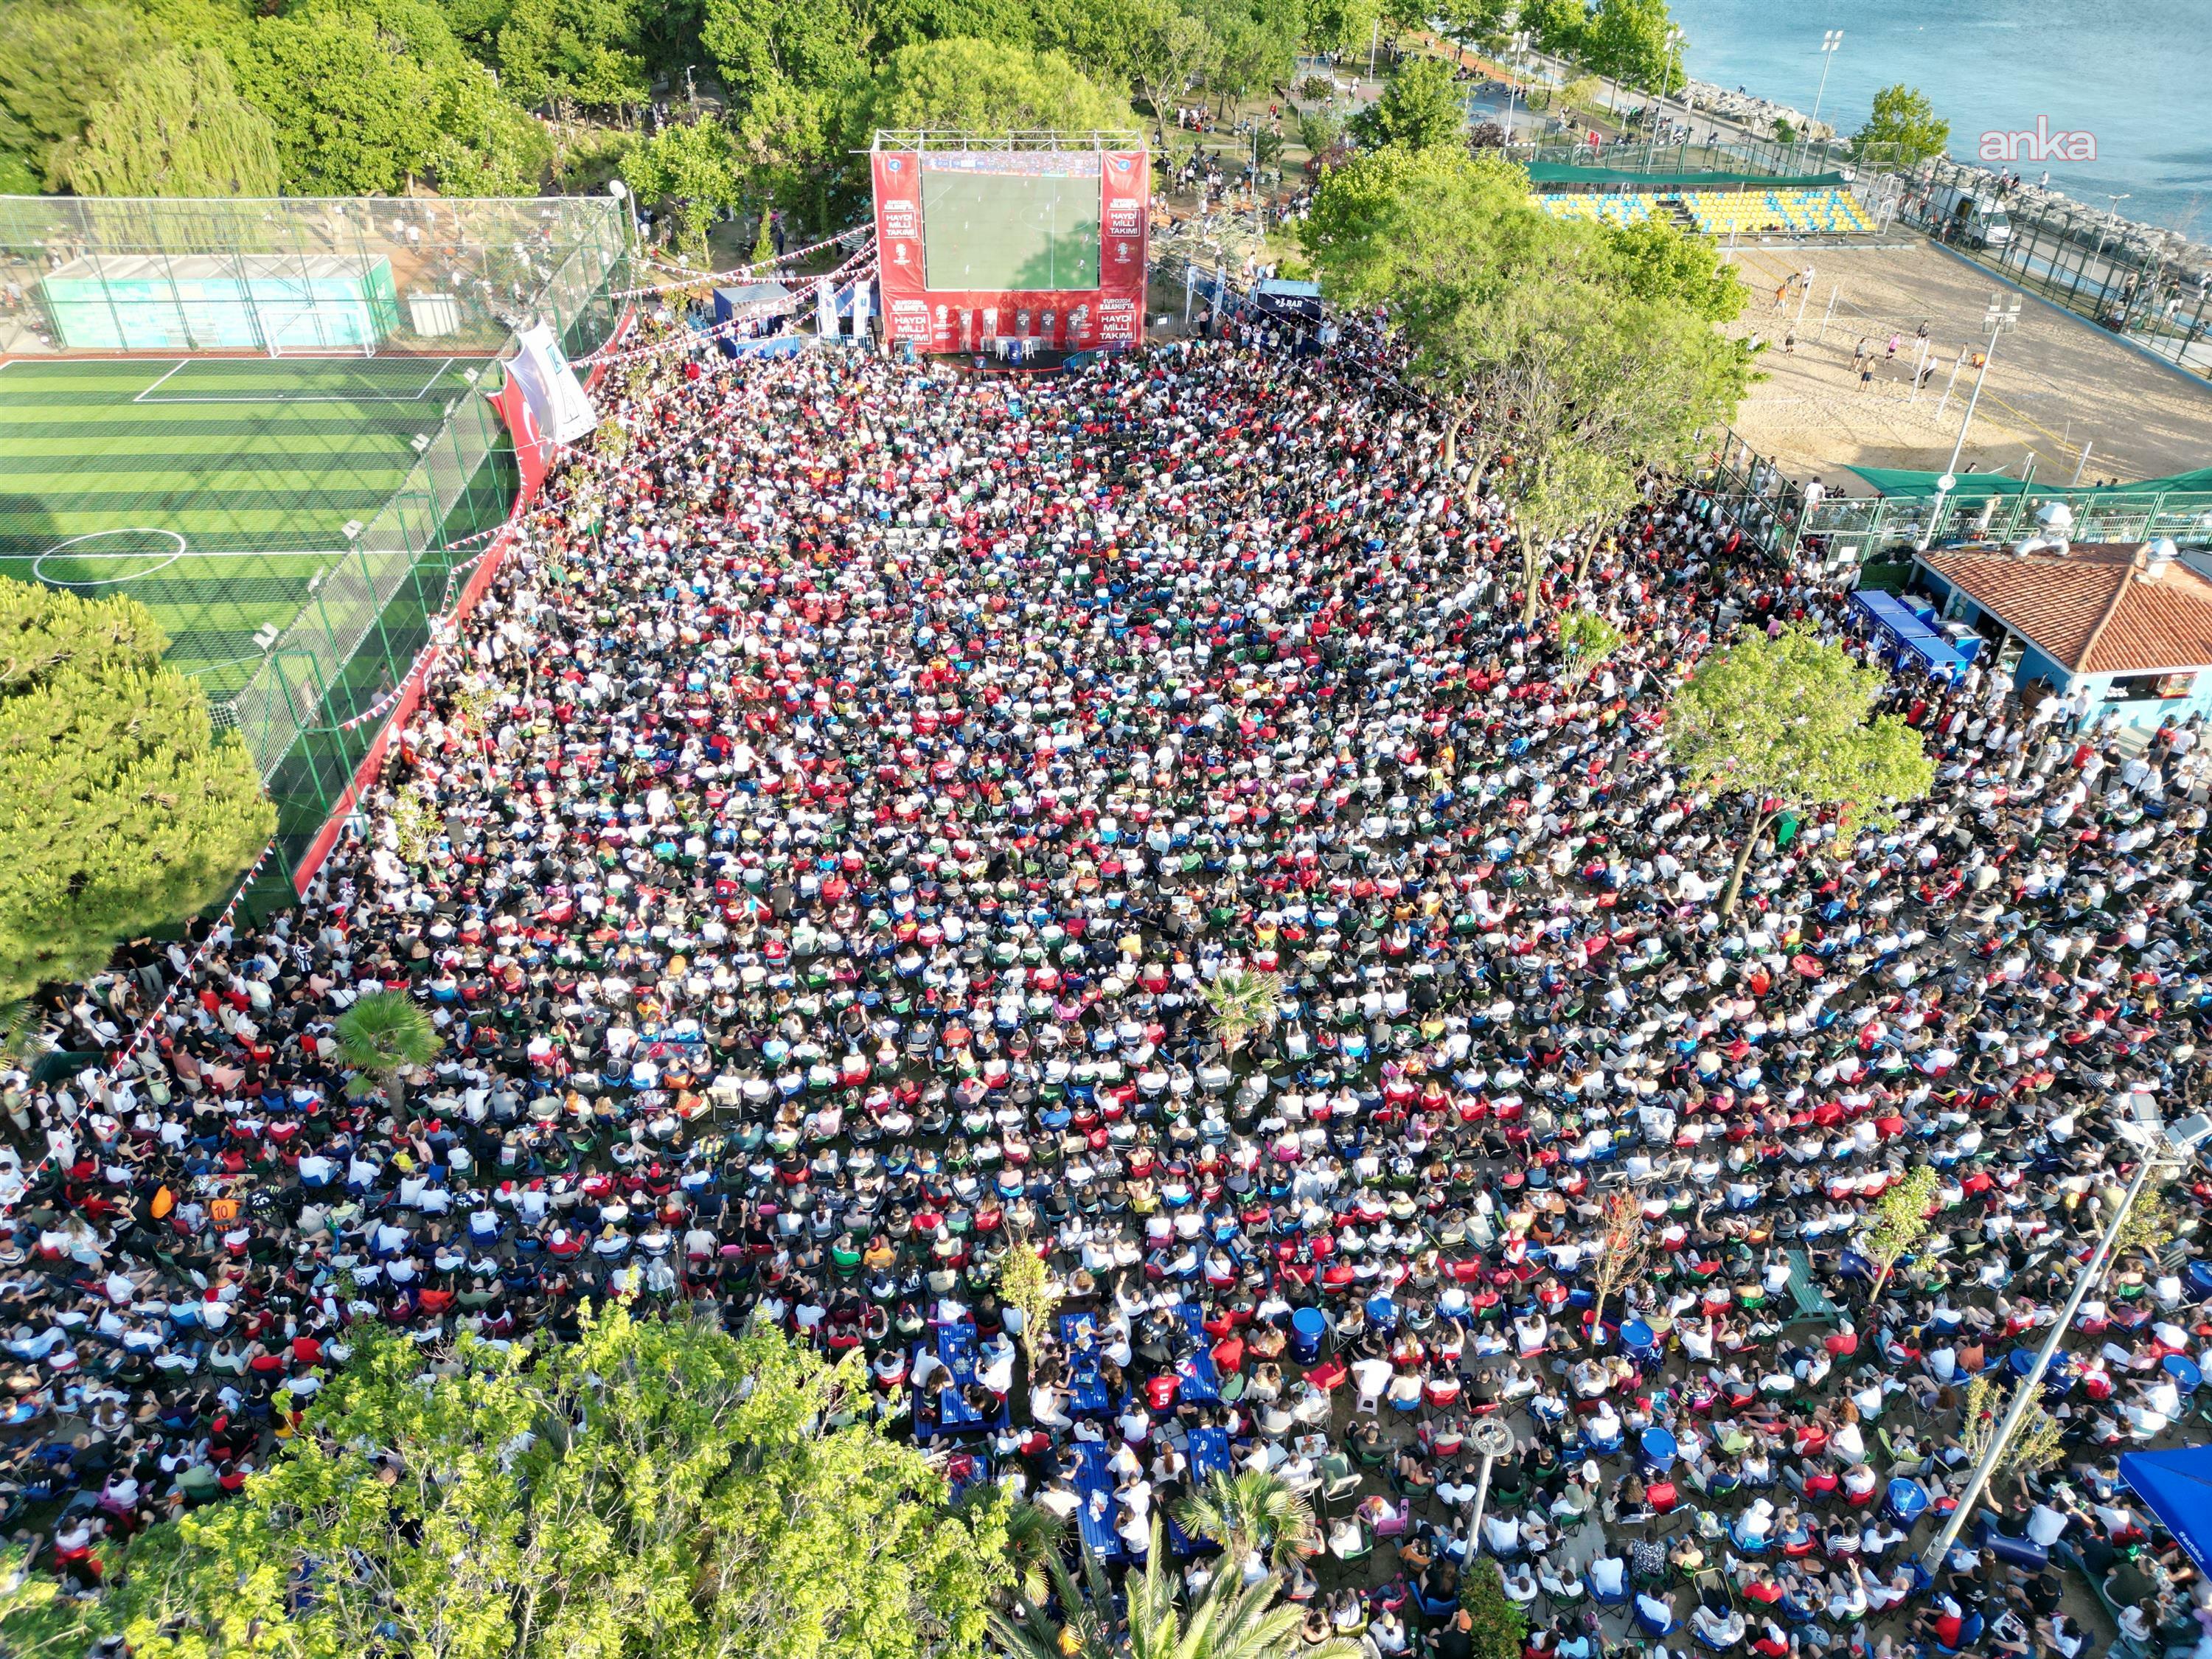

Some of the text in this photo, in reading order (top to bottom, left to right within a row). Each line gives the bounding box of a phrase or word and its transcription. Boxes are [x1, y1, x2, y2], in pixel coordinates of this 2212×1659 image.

[886, 213, 913, 221] HAYDİ
[1110, 211, 1137, 220] HAYDİ
[888, 220, 911, 229] MİLLİ
[1113, 219, 1135, 227] MİLLİ
[1286, 299, 1303, 307] BAR
[894, 316, 926, 324] HAYDİ
[1101, 313, 1133, 322] HAYDİ
[897, 324, 925, 333] MİLLİ
[1103, 321, 1130, 331] MİLLİ
[1099, 332, 1133, 340] TAKIM!
[215, 1205, 228, 1218] 10
[1159, 1393, 1169, 1405] 5
